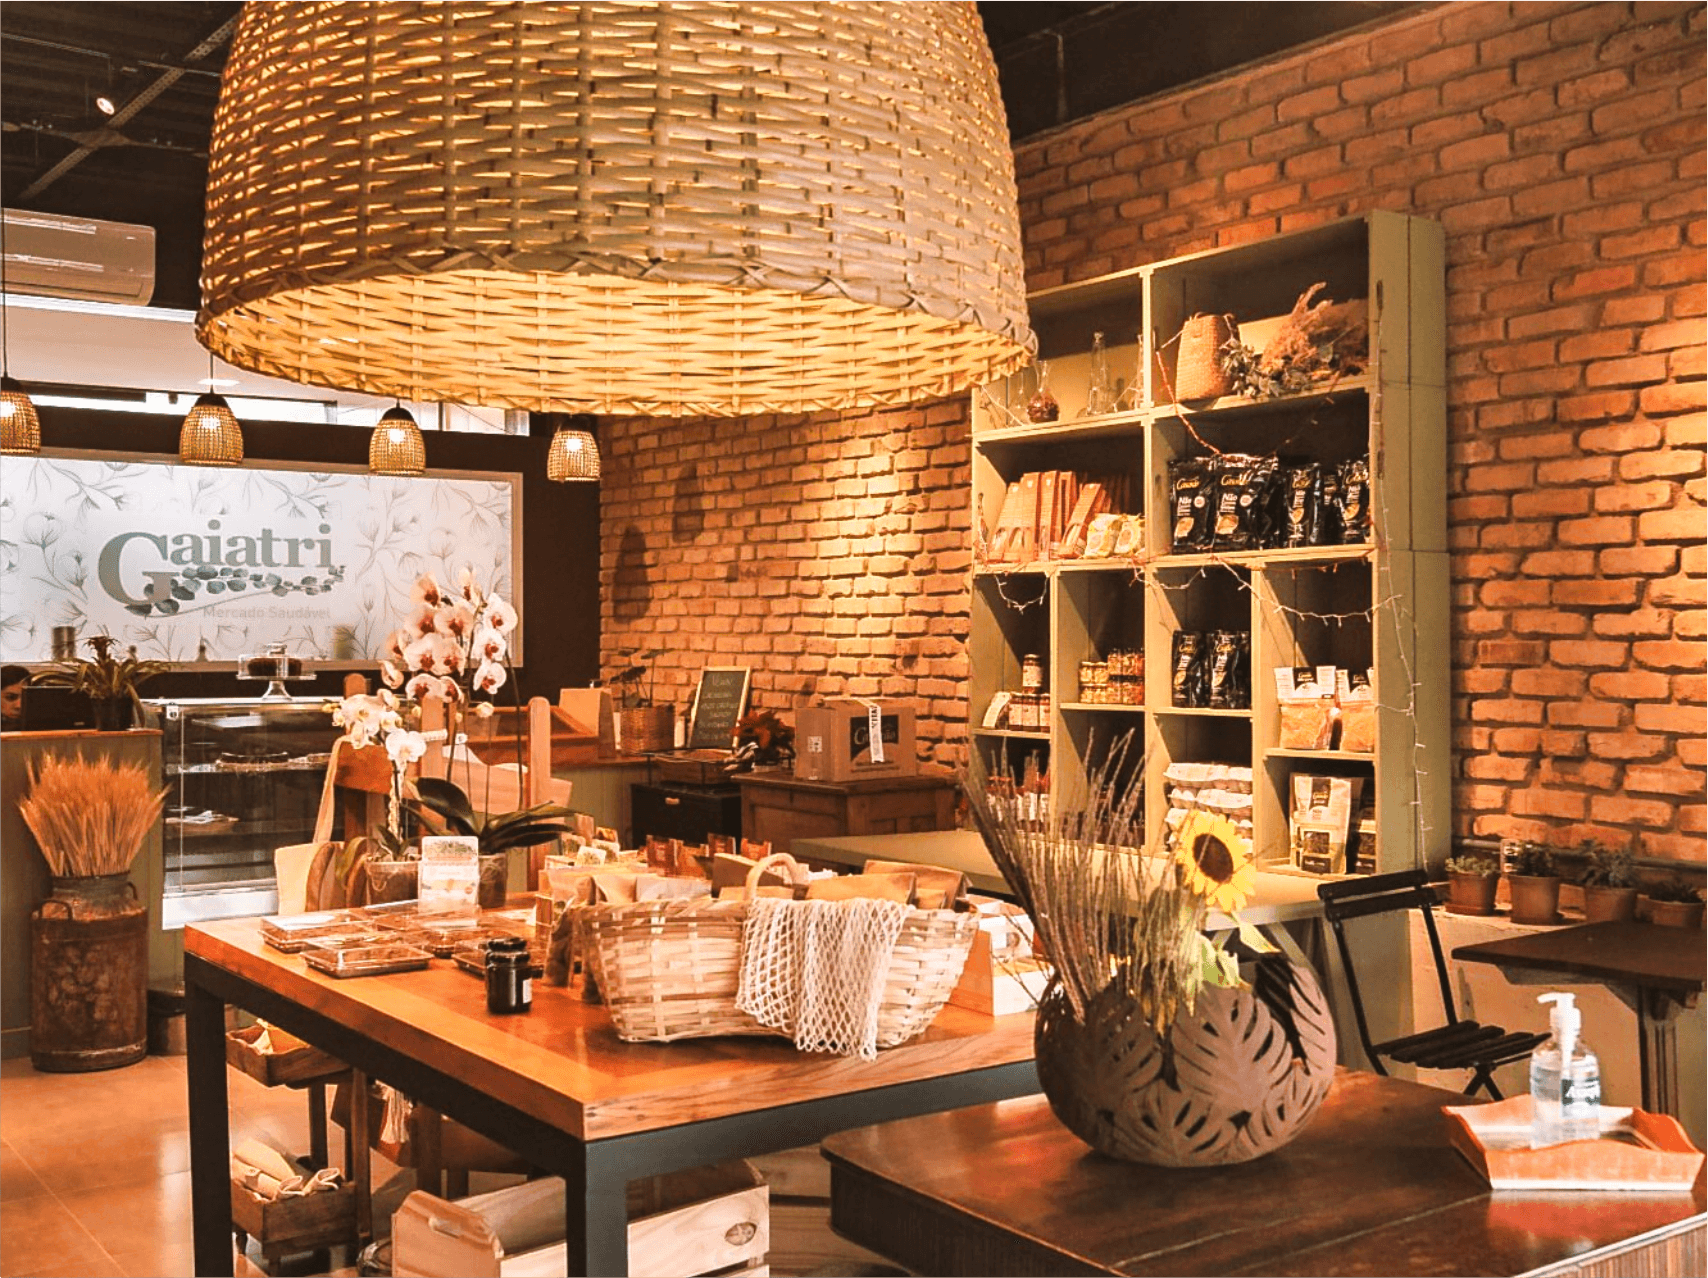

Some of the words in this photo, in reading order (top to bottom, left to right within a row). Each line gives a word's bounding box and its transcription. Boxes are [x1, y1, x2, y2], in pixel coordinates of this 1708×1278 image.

[98, 519, 333, 606] Gaiatri
[203, 606, 265, 618] Mercado
[268, 606, 331, 619] Saudável
